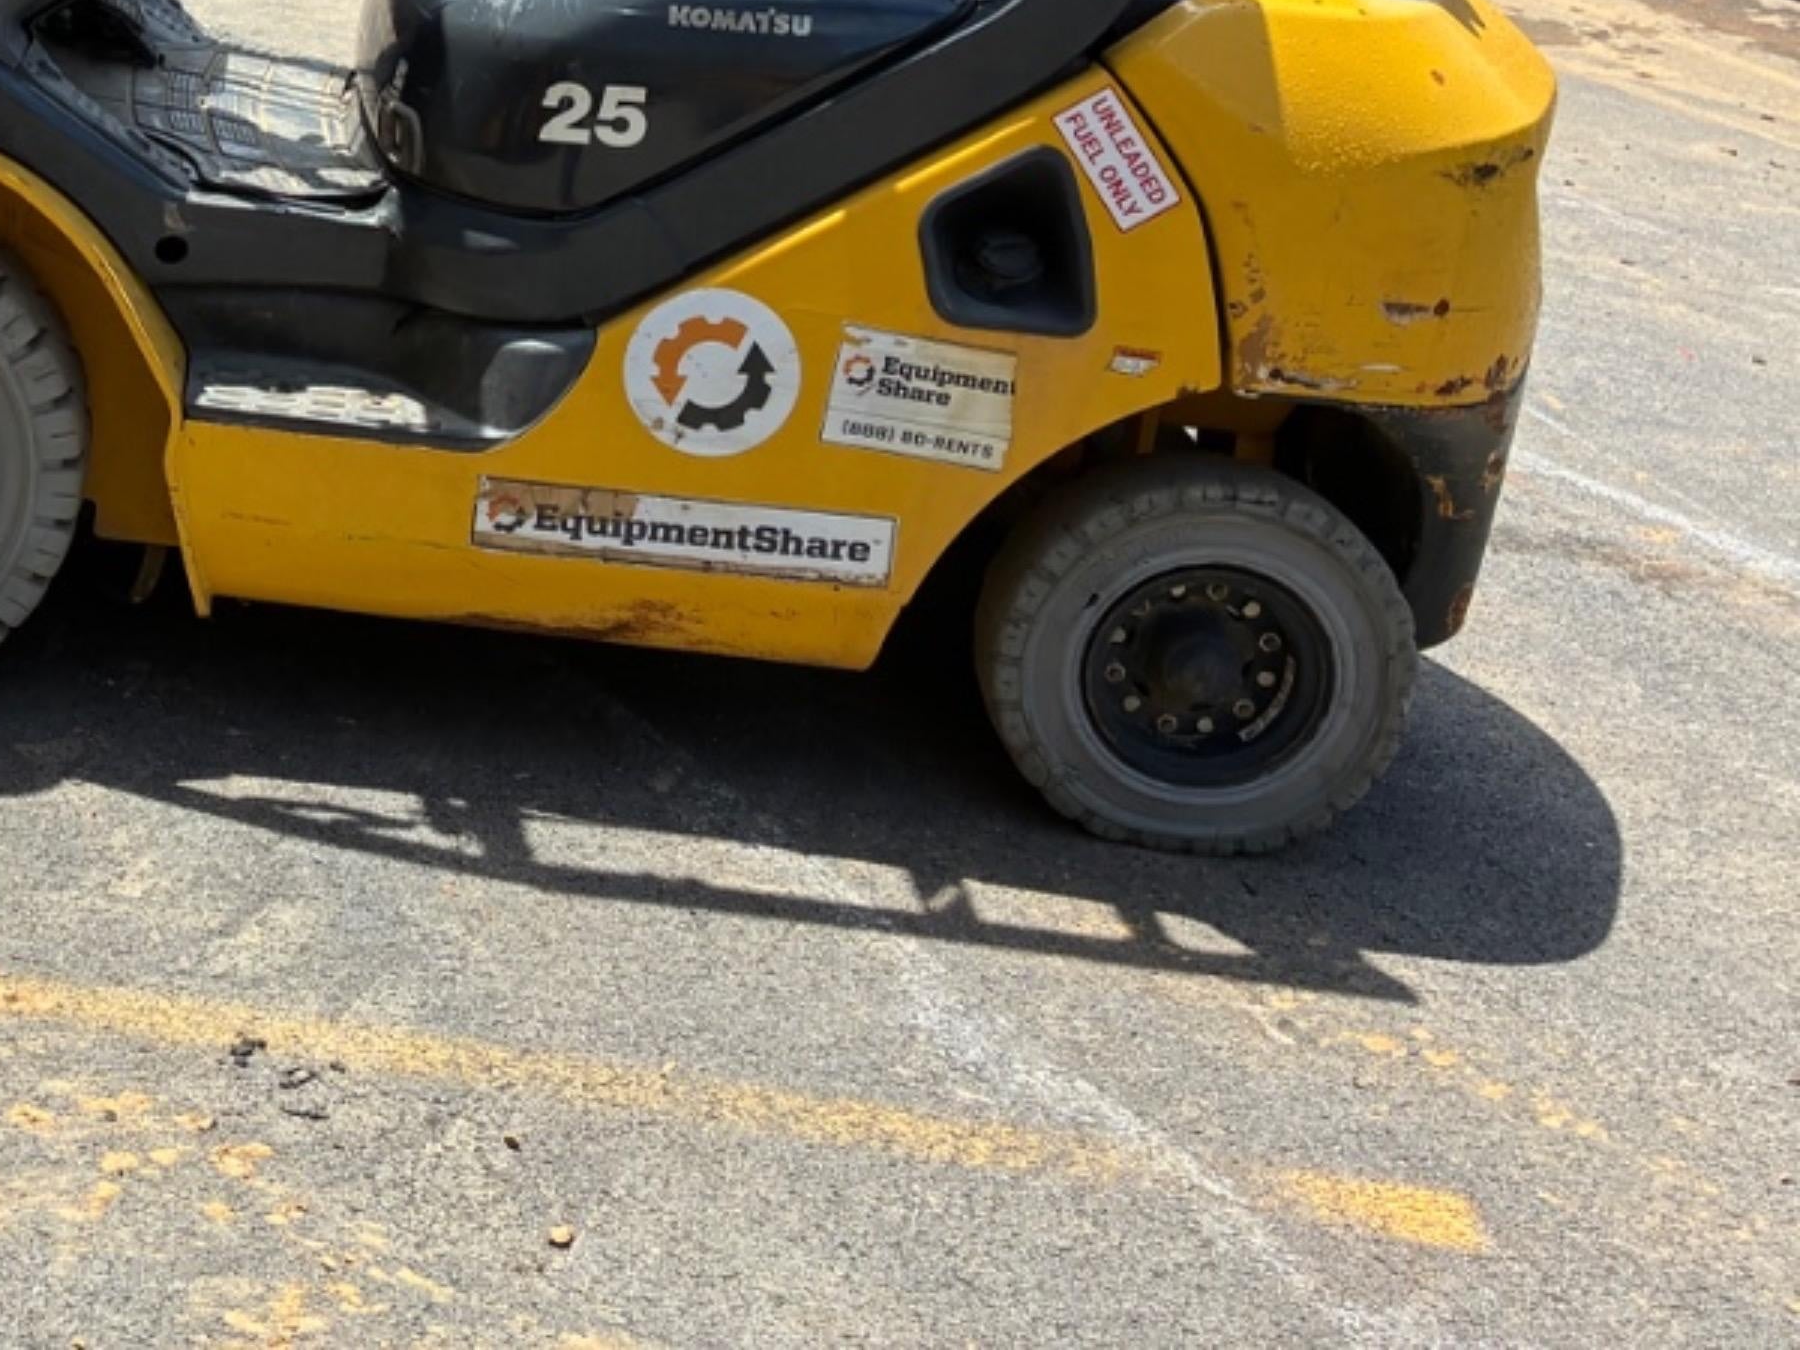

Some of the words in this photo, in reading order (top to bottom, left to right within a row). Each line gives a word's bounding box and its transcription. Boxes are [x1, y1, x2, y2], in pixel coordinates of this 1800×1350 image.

[668, 4, 813, 37] KOMATSU
[538, 80, 648, 148] 25
[1065, 111, 1104, 166] FUEL
[1100, 165, 1144, 217] ONLY
[1092, 95, 1166, 204] UNLEADED
[876, 376, 952, 407] Share
[842, 418, 896, 443] (888)
[533, 504, 872, 562] EquipmentShare
